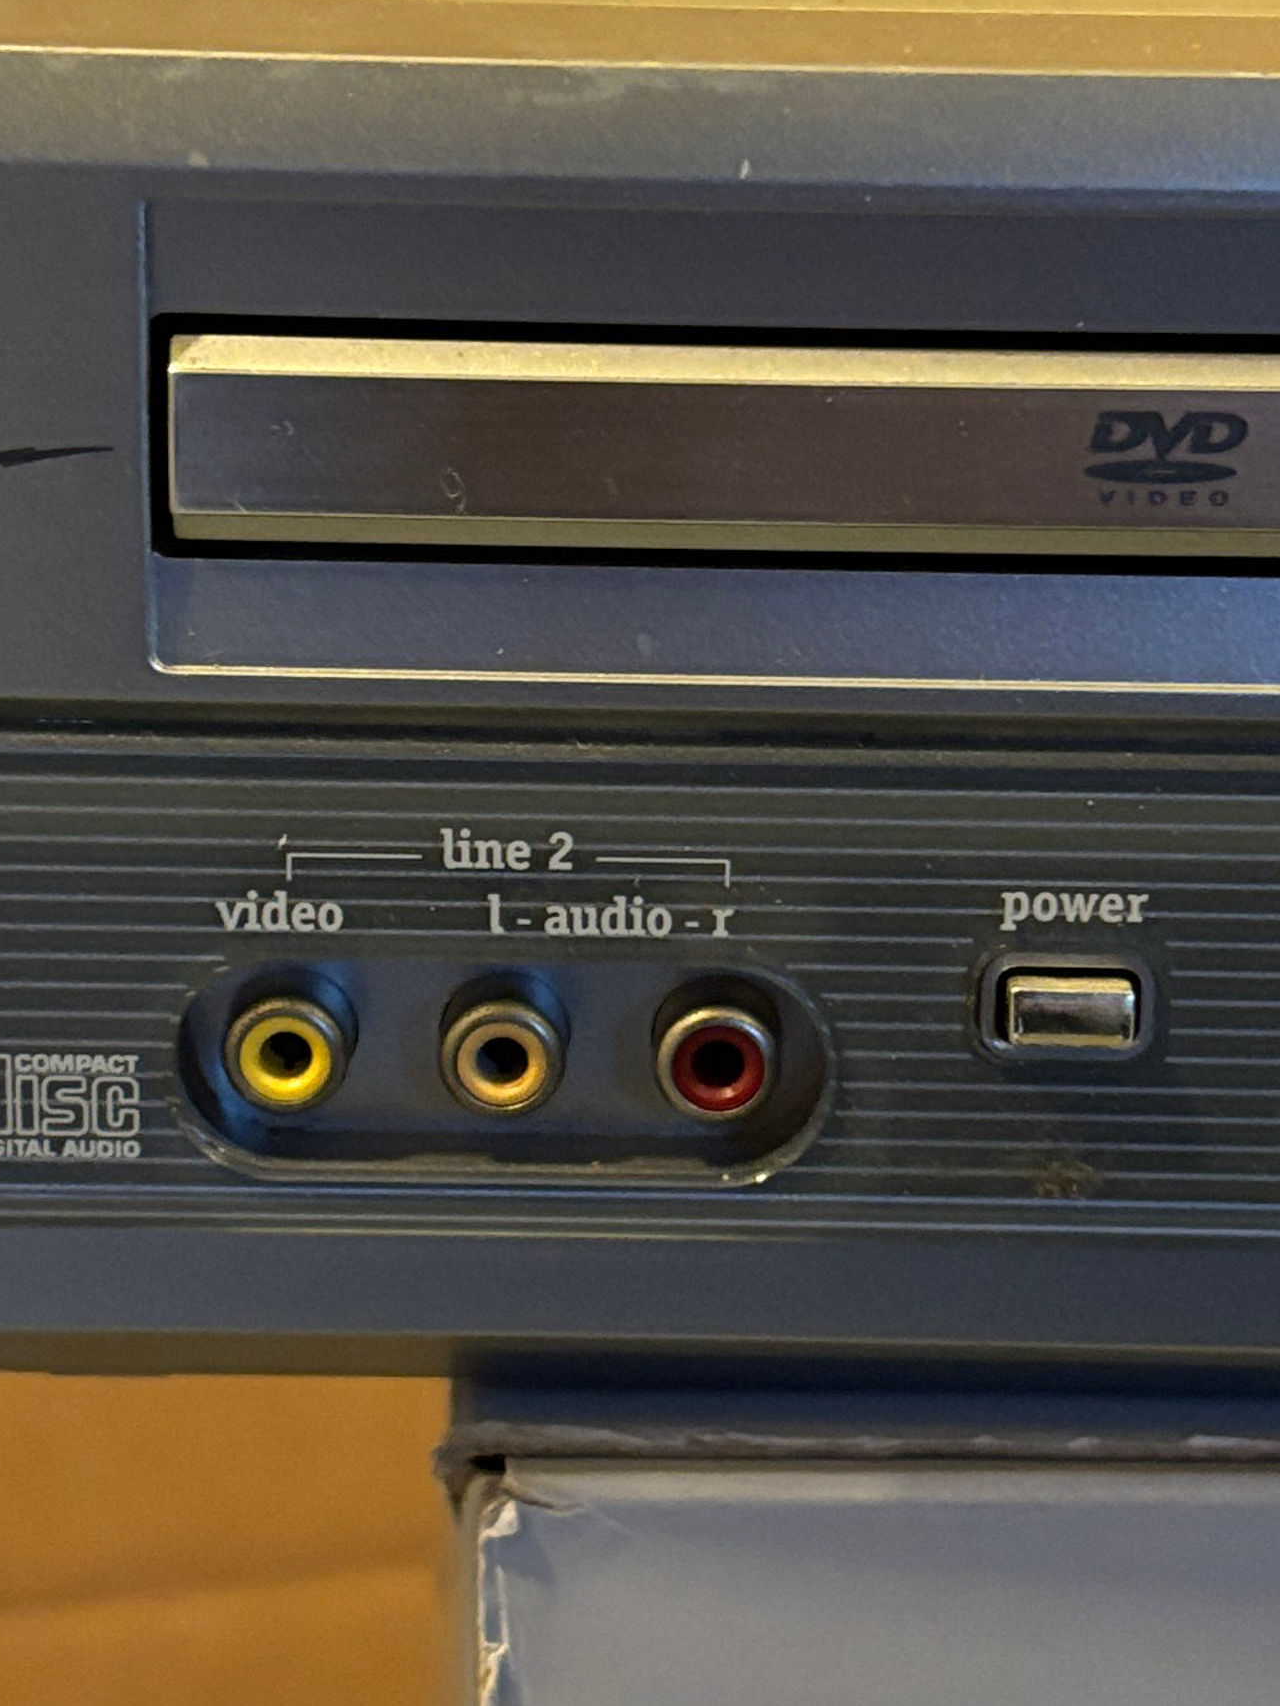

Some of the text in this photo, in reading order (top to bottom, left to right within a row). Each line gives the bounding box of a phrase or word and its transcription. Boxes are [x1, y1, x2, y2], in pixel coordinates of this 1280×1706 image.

[1090, 410, 1248, 461] DVD
[1099, 490, 1229, 506] VIDEO
[440, 828, 574, 871] line 2
[216, 890, 344, 932] video
[544, 895, 672, 937] audio
[711, 906, 735, 939] r
[999, 891, 1149, 931] power
[14, 1054, 140, 1074] COMPACT
[58, 1140, 141, 1159] AUDIO
